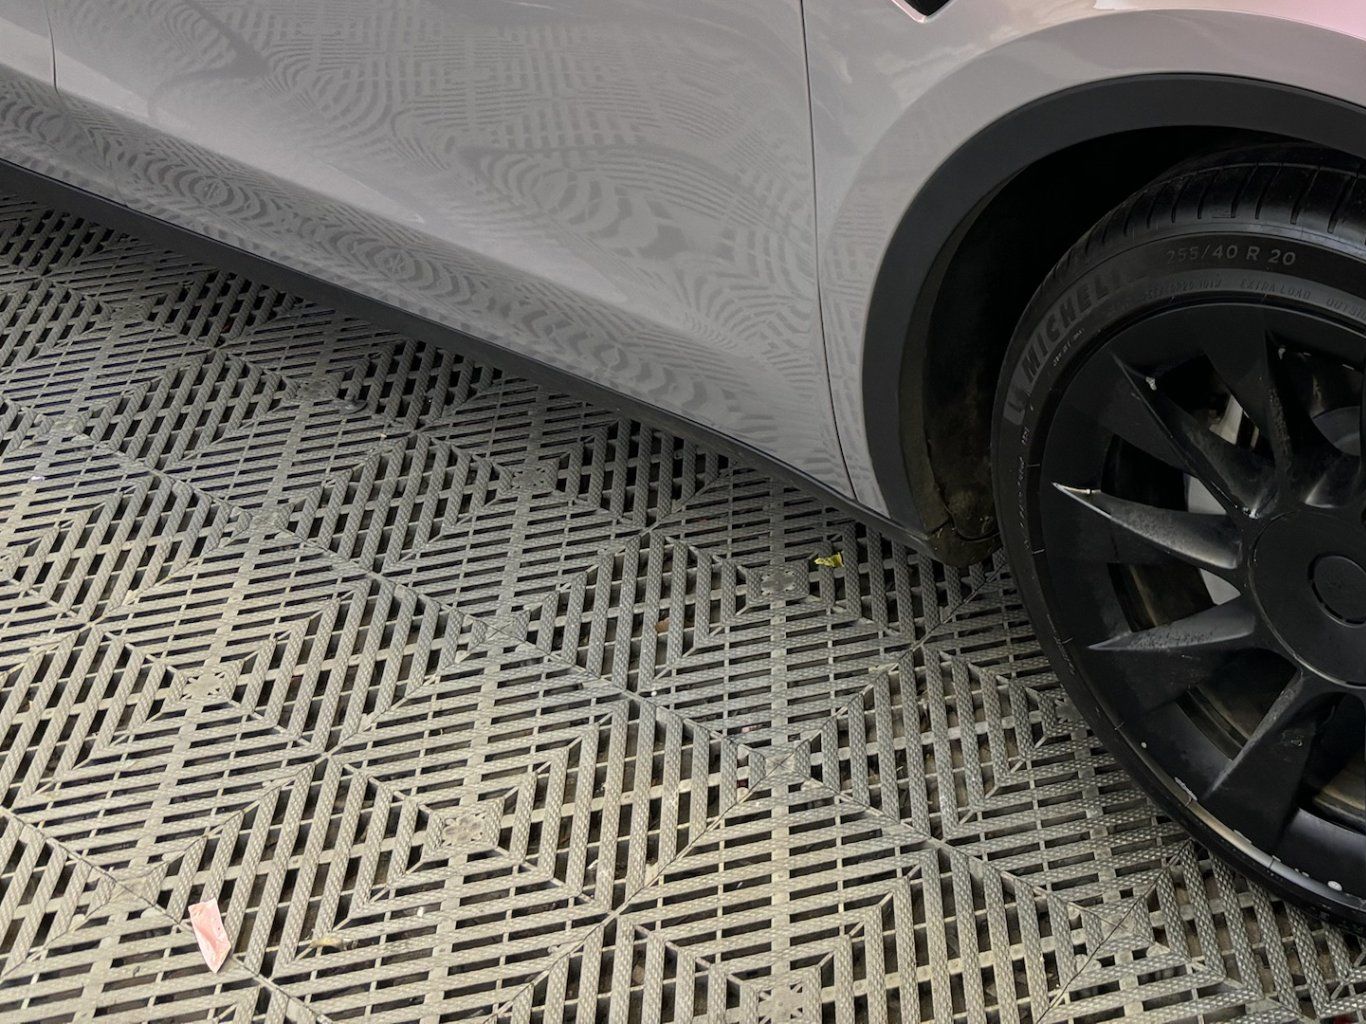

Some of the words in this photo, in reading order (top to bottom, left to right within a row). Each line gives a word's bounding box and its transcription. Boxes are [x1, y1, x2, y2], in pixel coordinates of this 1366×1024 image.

[1166, 244, 1239, 264] 255/40
[1246, 245, 1261, 262] R
[1268, 248, 1297, 266] 20
